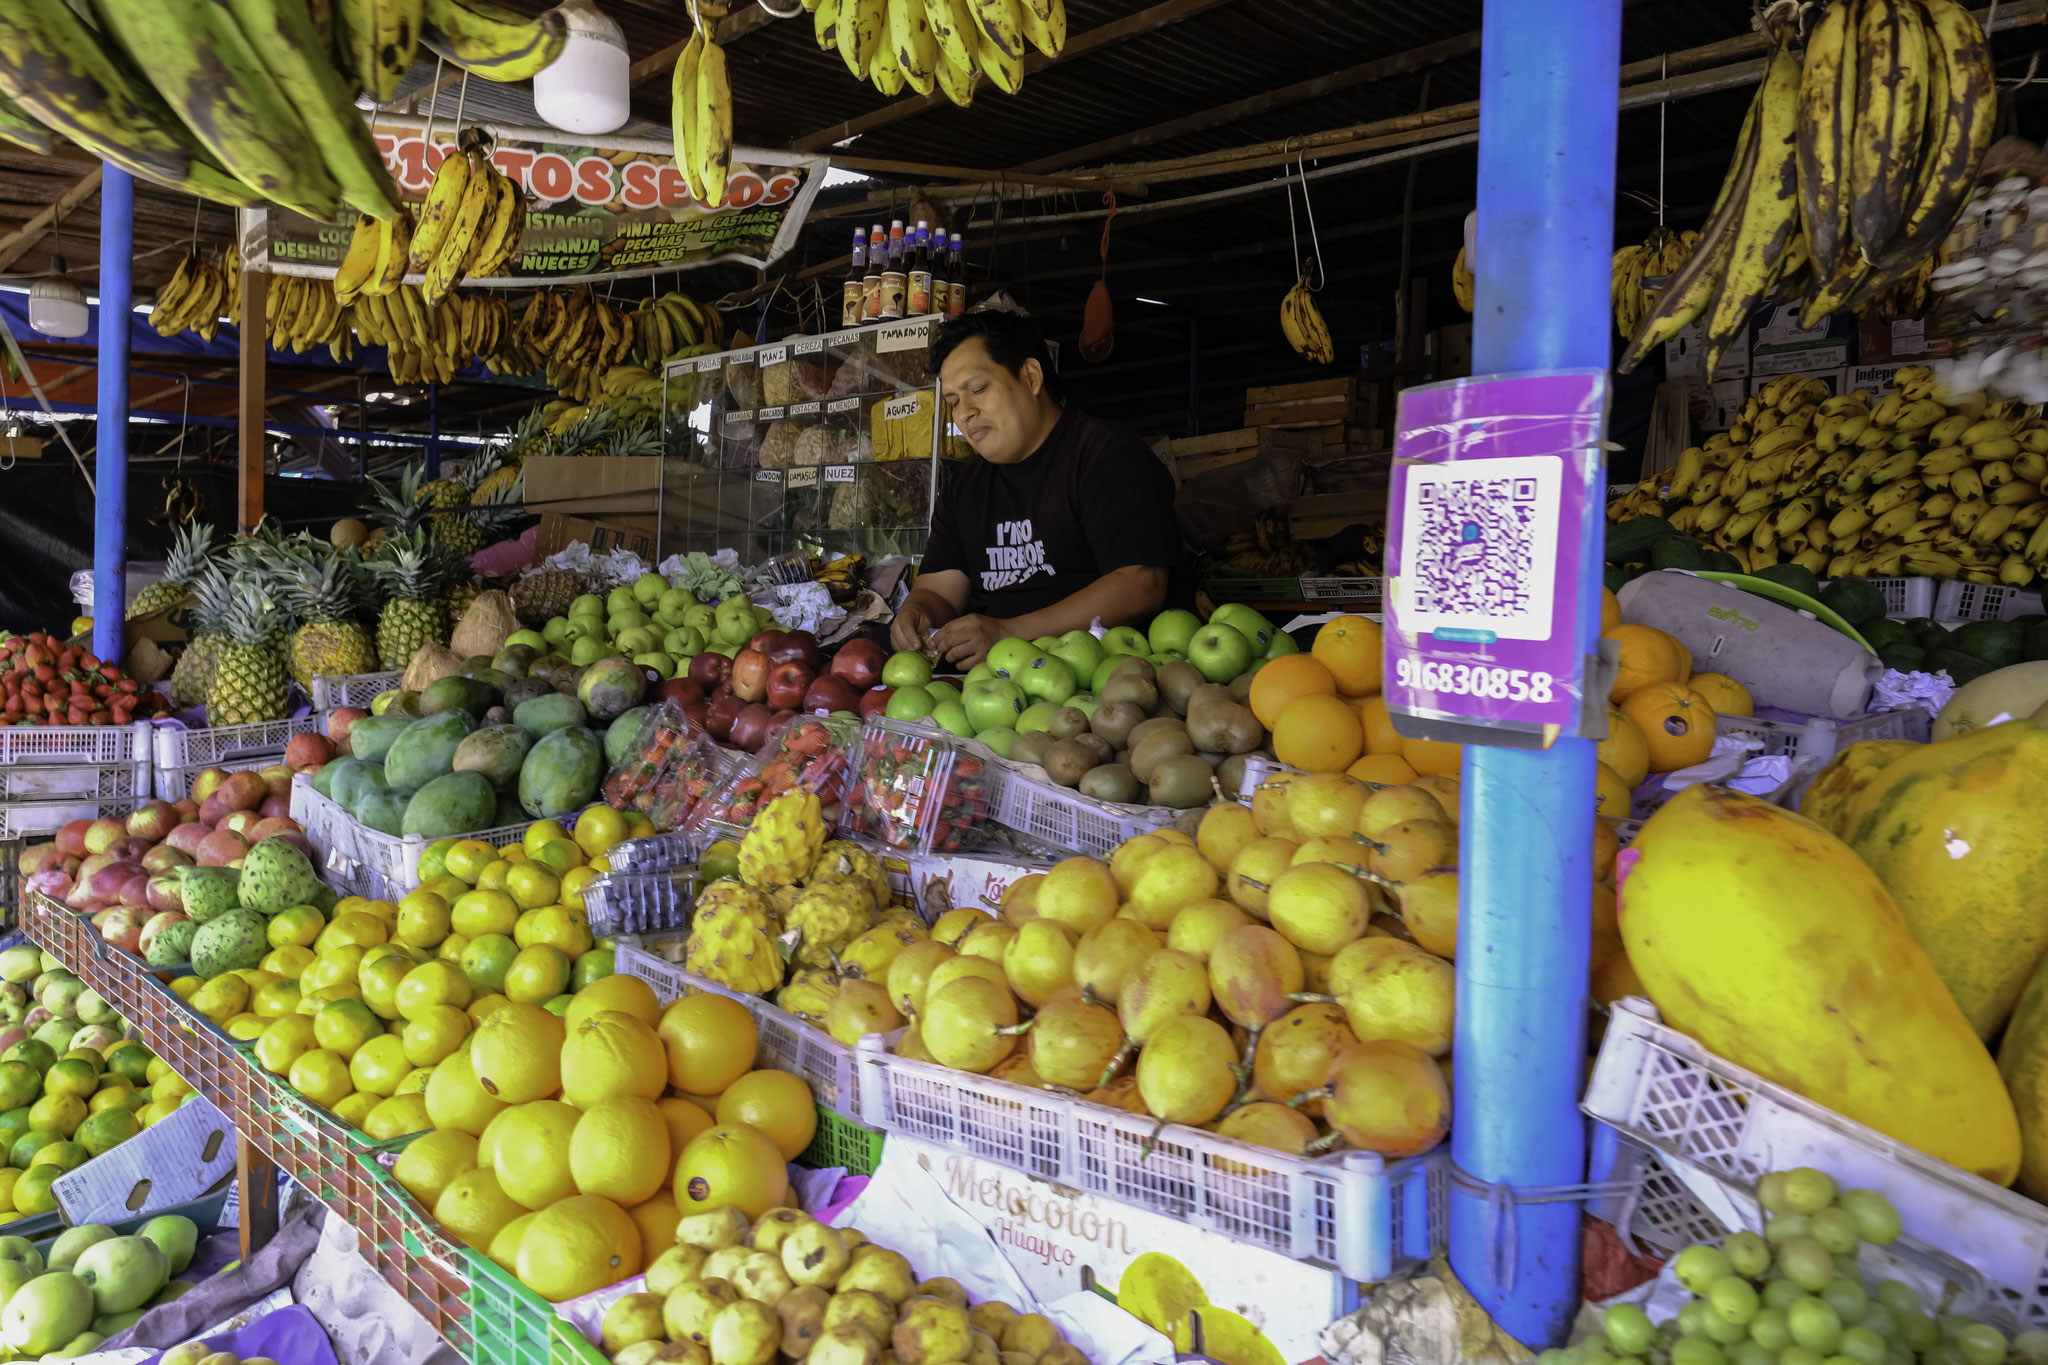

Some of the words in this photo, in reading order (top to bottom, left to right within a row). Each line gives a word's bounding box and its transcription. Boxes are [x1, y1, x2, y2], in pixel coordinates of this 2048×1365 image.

[372, 134, 613, 204] RTOS
[621, 162, 799, 212] SEOS
[525, 212, 603, 235] ISTACHO
[652, 220, 702, 236] CEREZA
[319, 228, 354, 244] COC
[703, 224, 777, 241] MANZANAS
[624, 234, 684, 250] PECANAS
[522, 255, 589, 270] NUECES
[611, 247, 685, 266] GLASEADAS
[796, 341, 822, 353] CEREZA
[829, 333, 859, 346] PECANAS
[698, 358, 721, 370] PASAS
[760, 408, 783, 418] ANACARDO
[791, 403, 819, 414] PISTACHO
[828, 399, 859, 412] ALMENDRA
[886, 401, 916, 418] AGUAJE
[790, 471, 817, 482] DAMASCO
[986, 545, 1027, 570] TIRE
[980, 570, 1021, 591] THIS
[1396, 658, 1553, 703] 916830858
